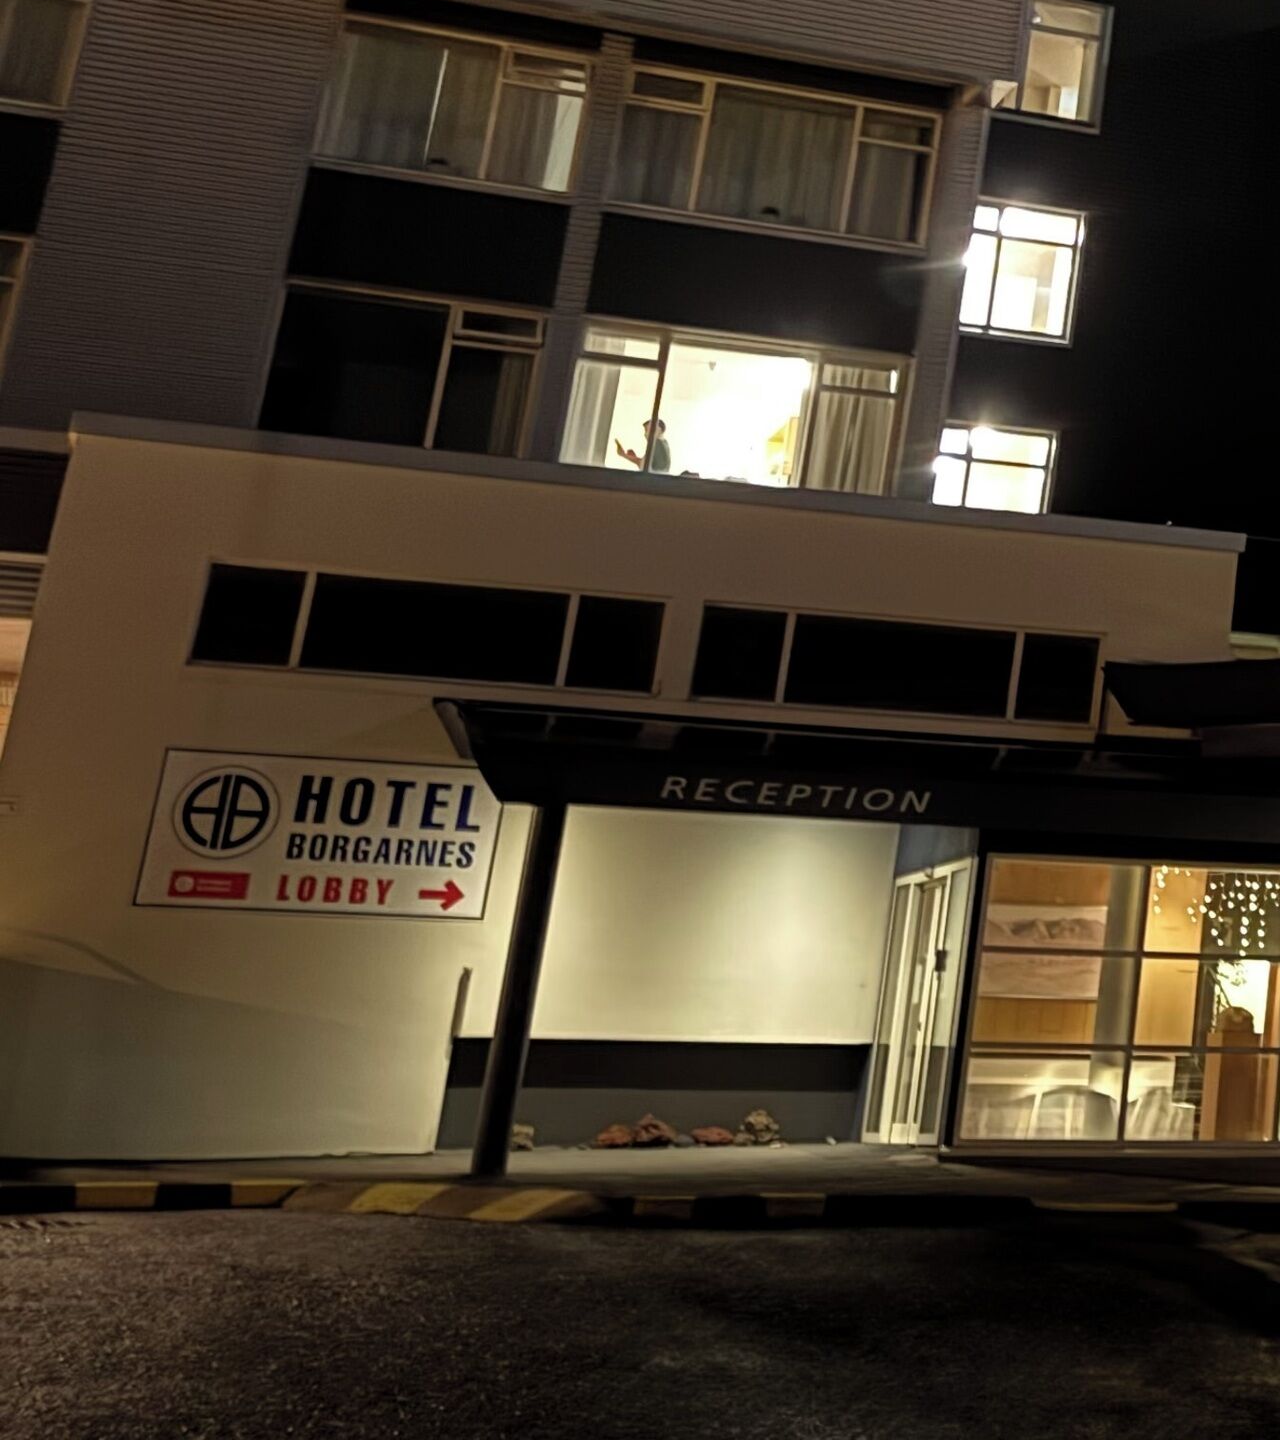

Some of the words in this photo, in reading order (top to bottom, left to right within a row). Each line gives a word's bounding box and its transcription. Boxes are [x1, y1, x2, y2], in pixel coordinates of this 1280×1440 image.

[293, 774, 480, 833] HOTEL
[659, 775, 932, 814] RECEPTION
[286, 832, 476, 869] BORGARNES
[276, 874, 394, 905] LOBBY
